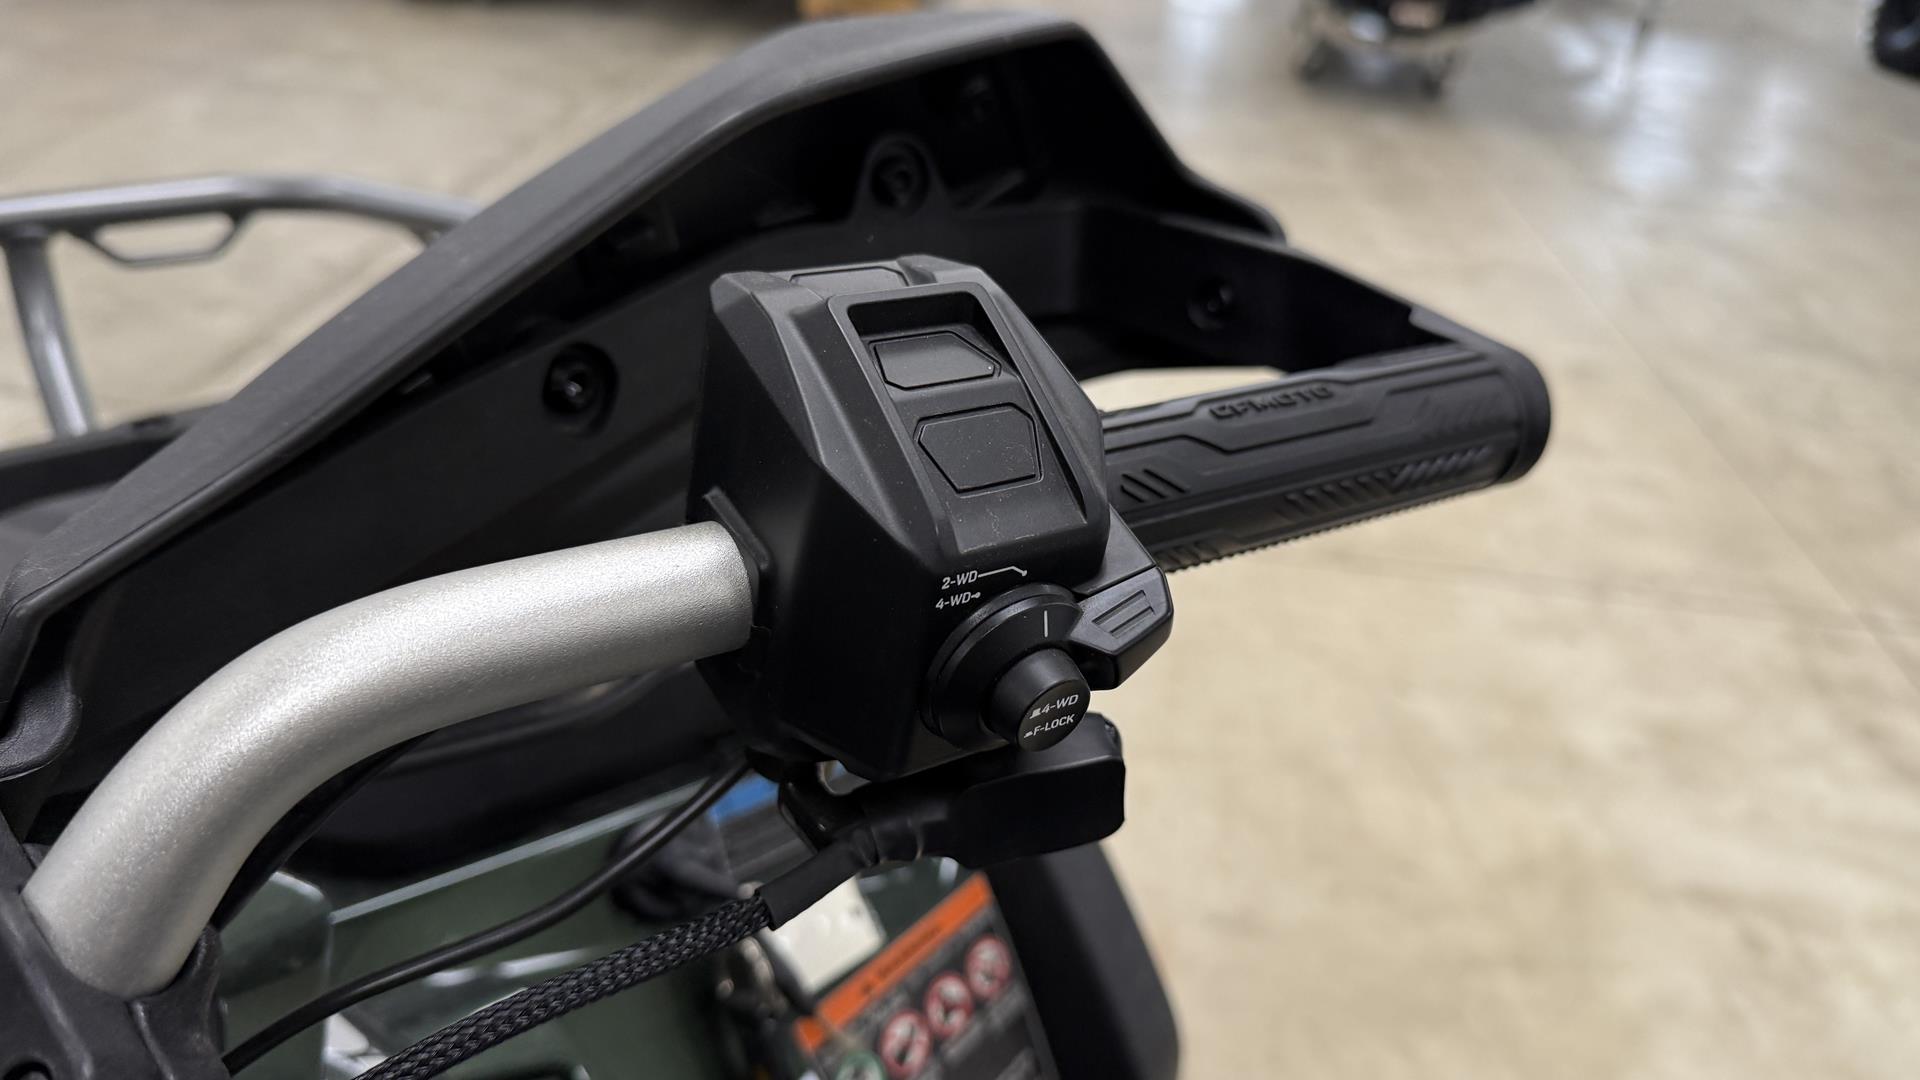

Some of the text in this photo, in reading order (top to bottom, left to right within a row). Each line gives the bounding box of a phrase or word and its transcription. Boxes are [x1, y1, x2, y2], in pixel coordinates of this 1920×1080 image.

[1209, 385, 1334, 419] CFMOTO
[941, 570, 978, 590] 2-WD
[935, 591, 972, 610] 4-WD
[1041, 694, 1079, 713] 4-WD
[1033, 713, 1075, 736] F-LOCK
